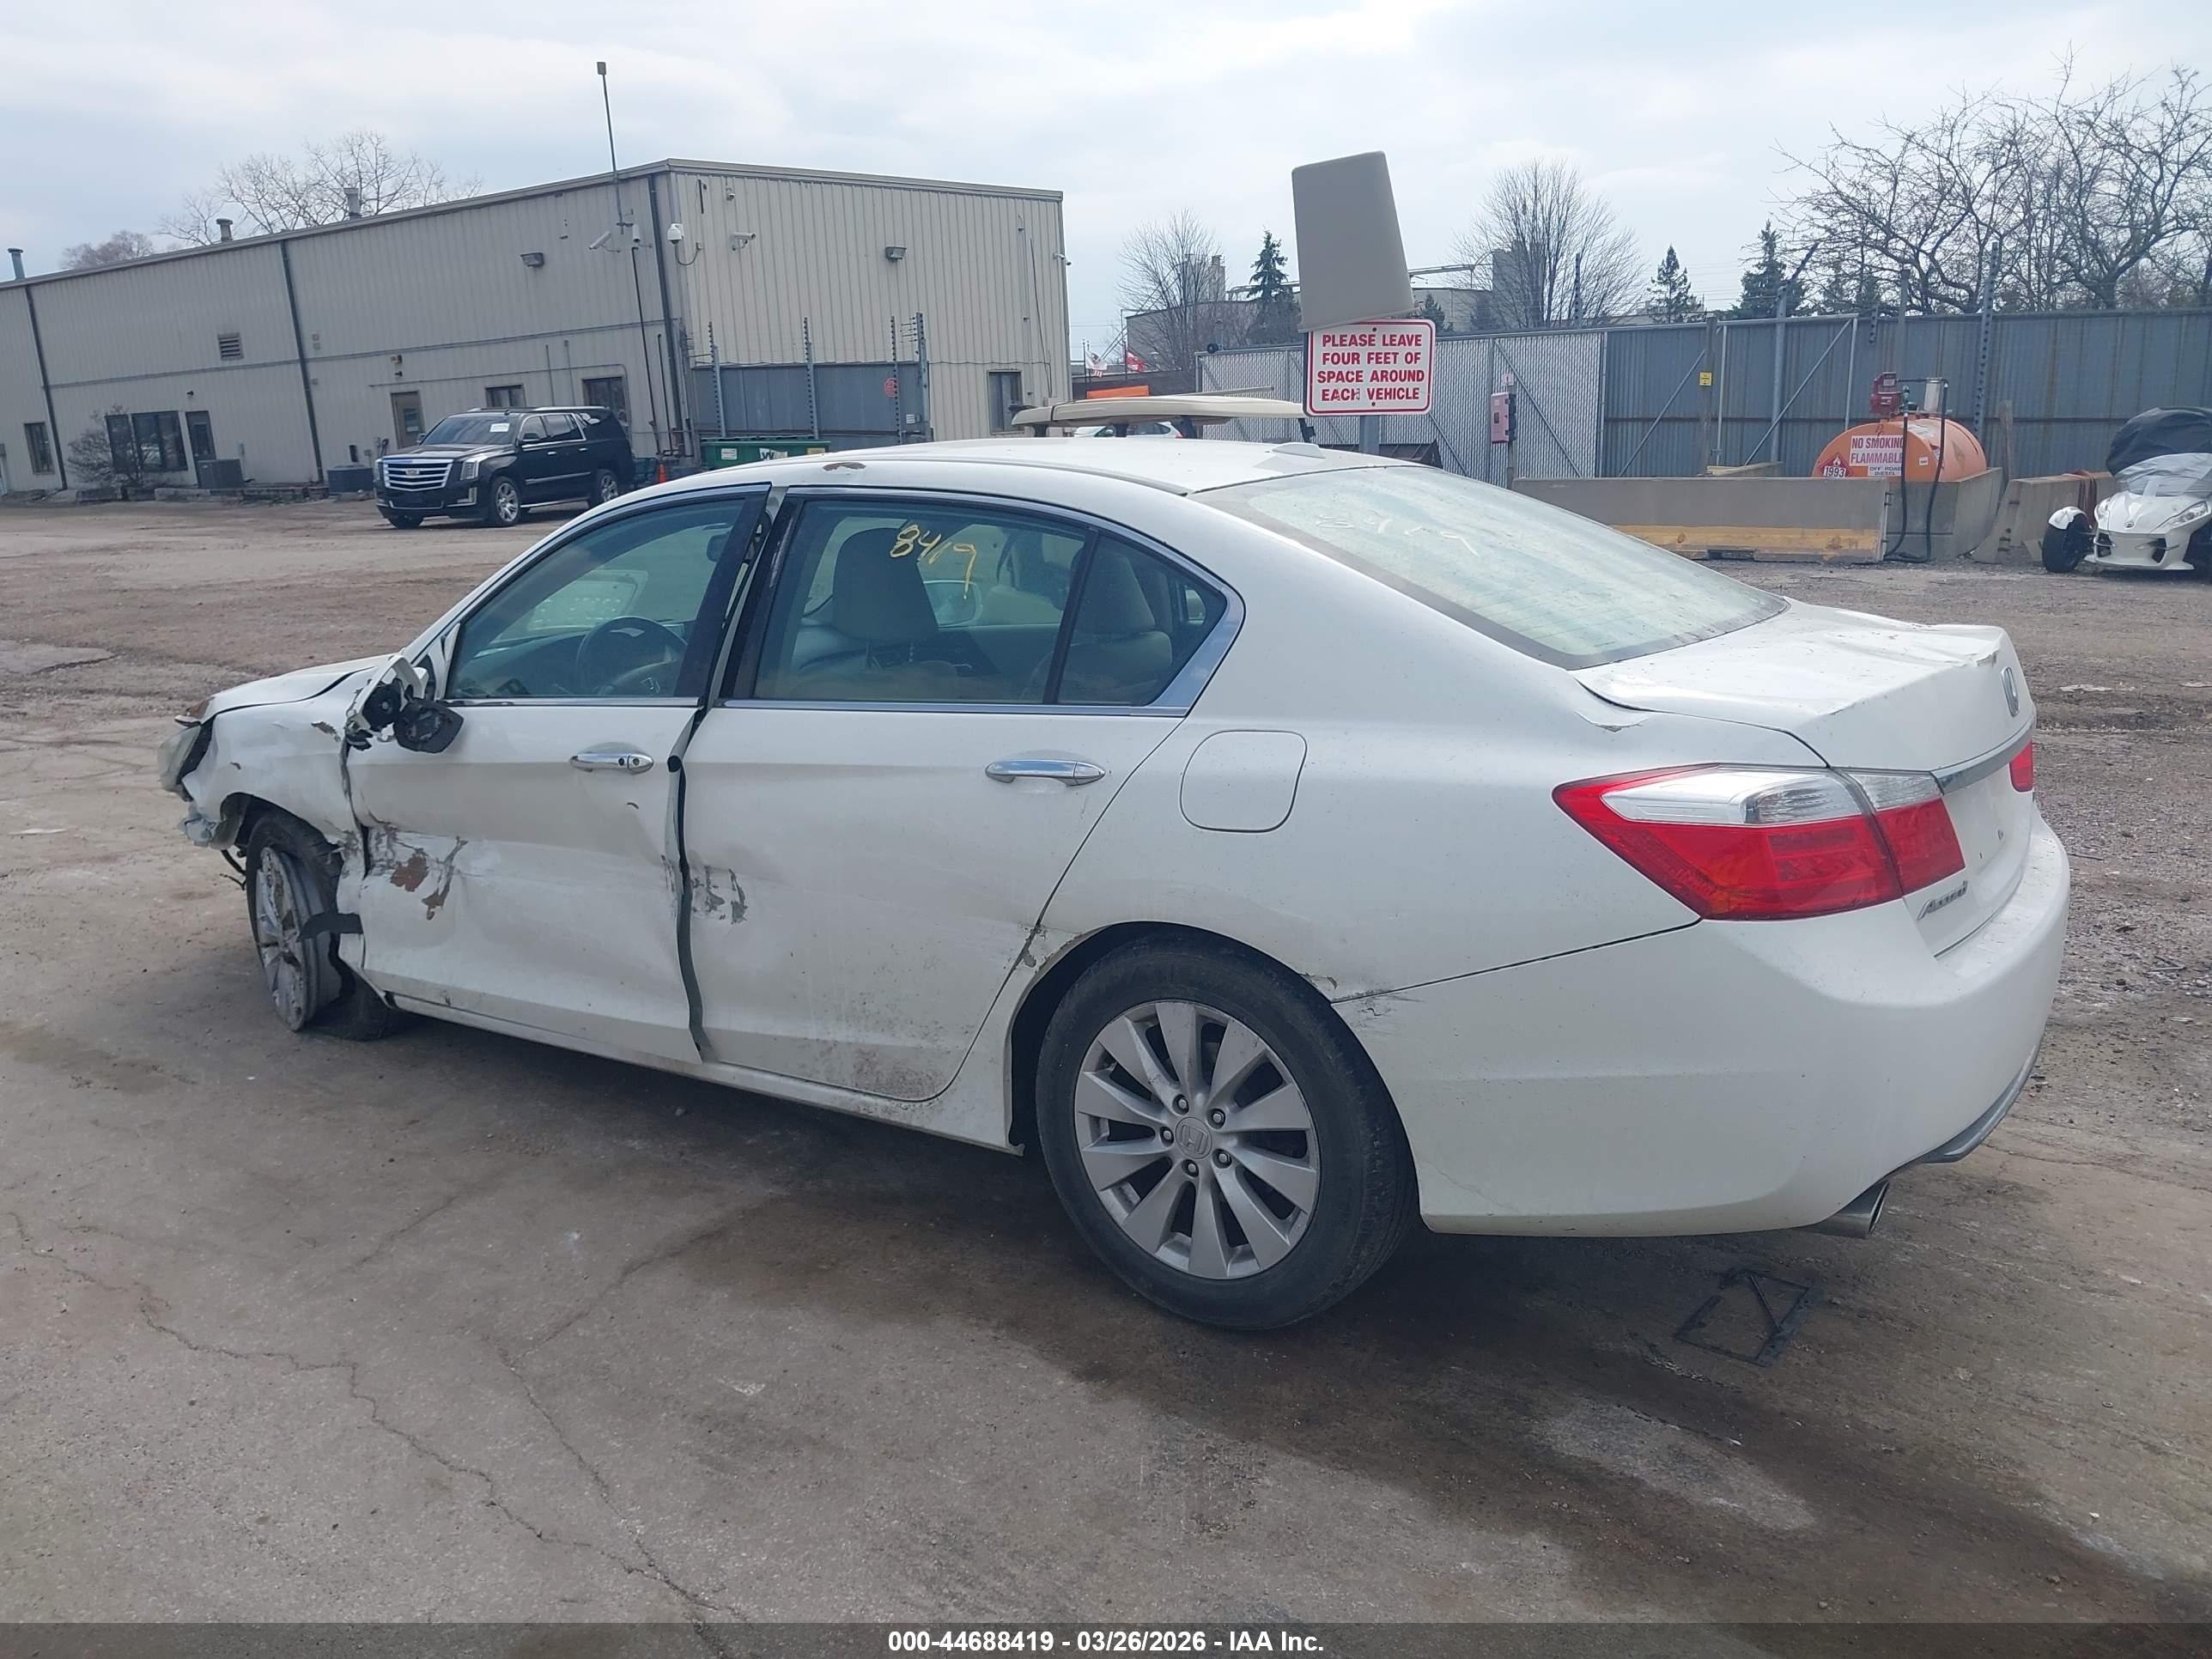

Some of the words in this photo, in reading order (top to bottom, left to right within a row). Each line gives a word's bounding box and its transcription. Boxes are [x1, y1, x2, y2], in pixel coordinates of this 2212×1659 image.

[1322, 334, 1376, 347] PLEASE
[1382, 334, 1422, 347] LEAVE
[1322, 353, 1360, 365] FOUR
[1367, 352, 1399, 365] FEET
[1405, 352, 1421, 365] OF
[1317, 370, 1364, 383] SPACE
[1370, 369, 1425, 383] AROUND
[1322, 388, 1360, 401] EACH
[1367, 387, 1419, 400] VEHICLE
[1851, 438, 1863, 449] NO
[1826, 466, 1845, 477] 1993
